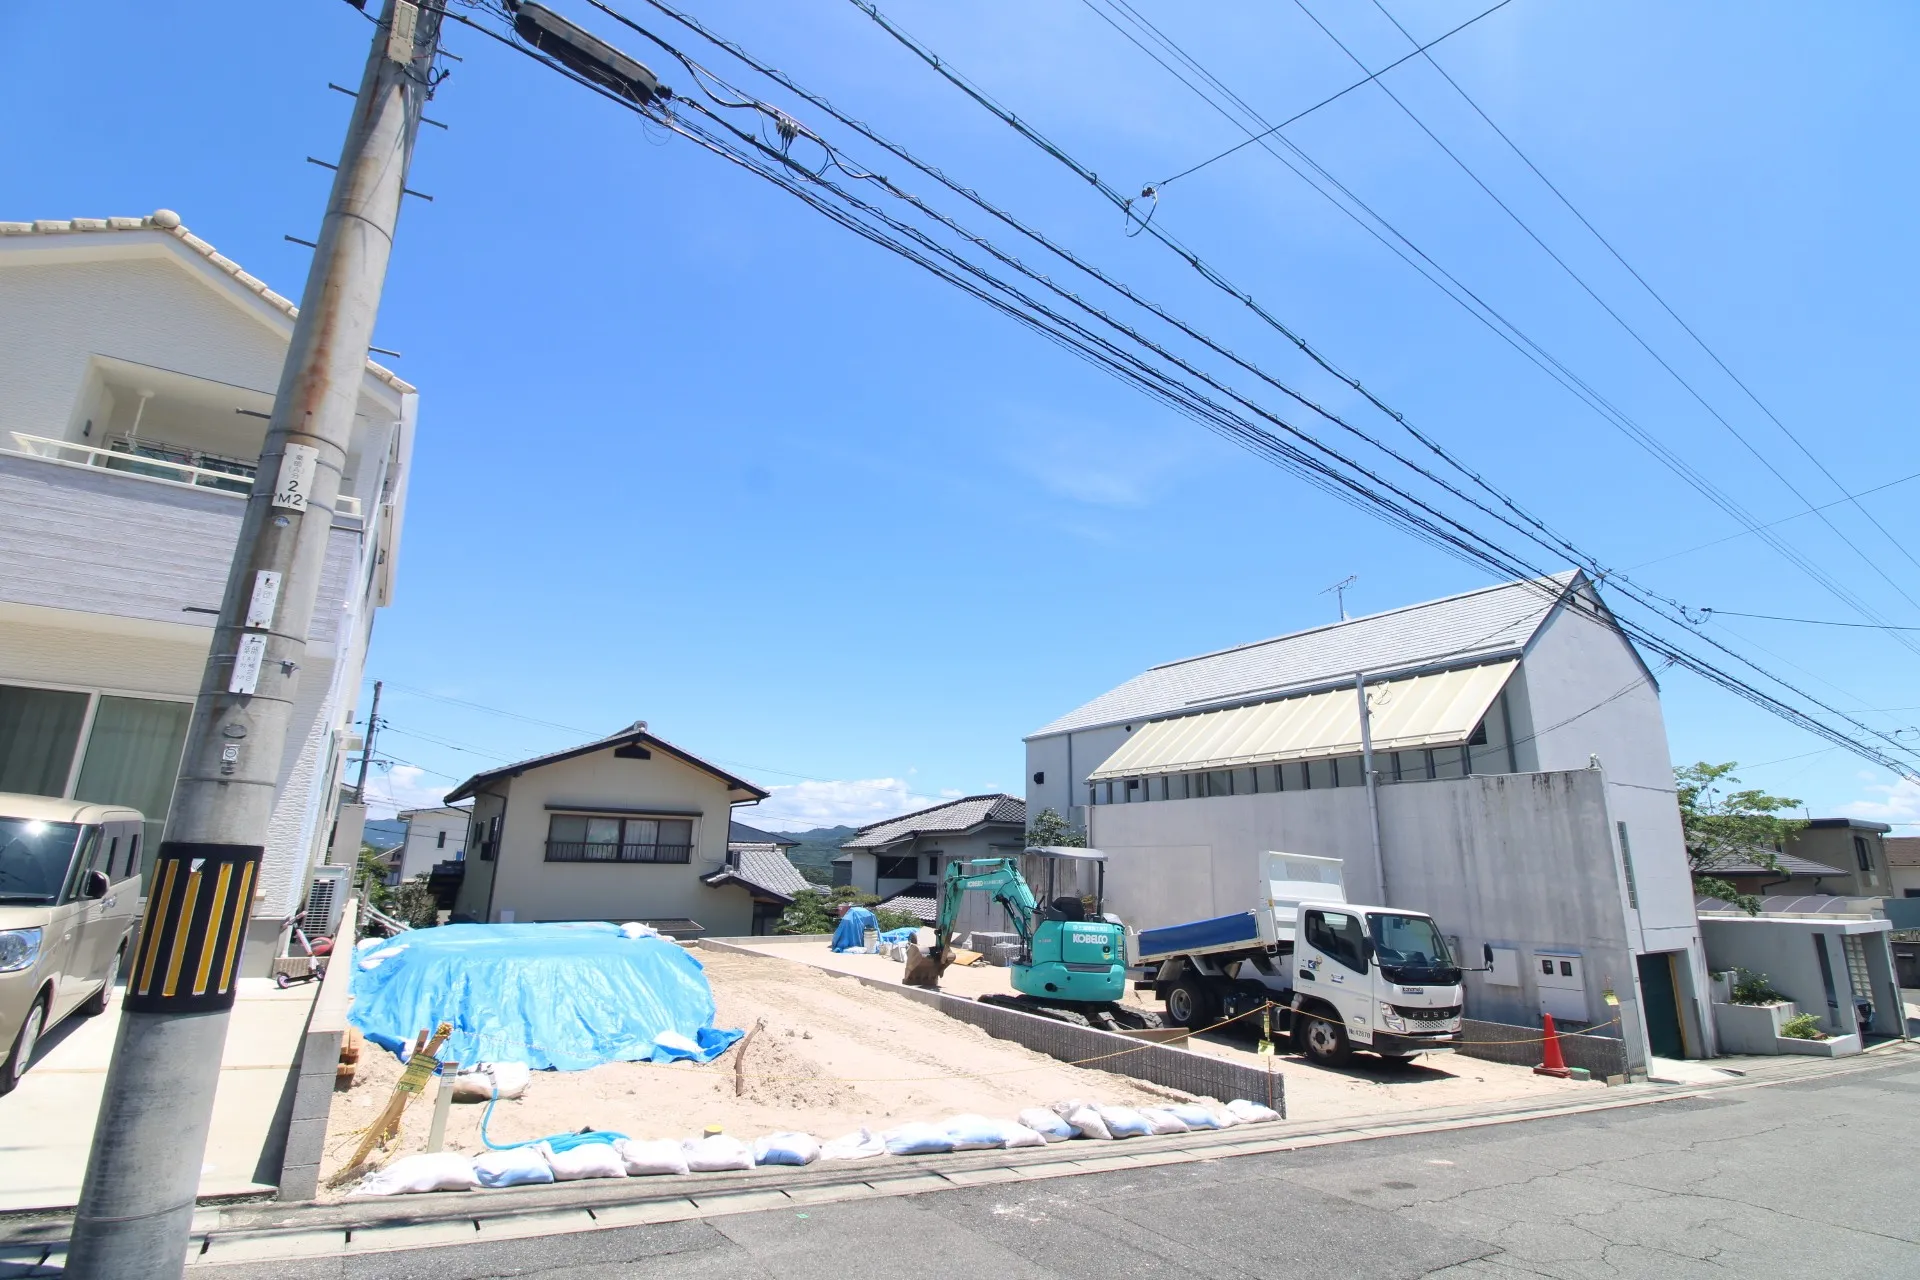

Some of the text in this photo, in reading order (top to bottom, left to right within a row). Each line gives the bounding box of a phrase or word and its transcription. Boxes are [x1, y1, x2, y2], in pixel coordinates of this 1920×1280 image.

[288, 480, 299, 492] 2
[278, 493, 303, 506] M2
[1072, 933, 1108, 945] KOBELCO
